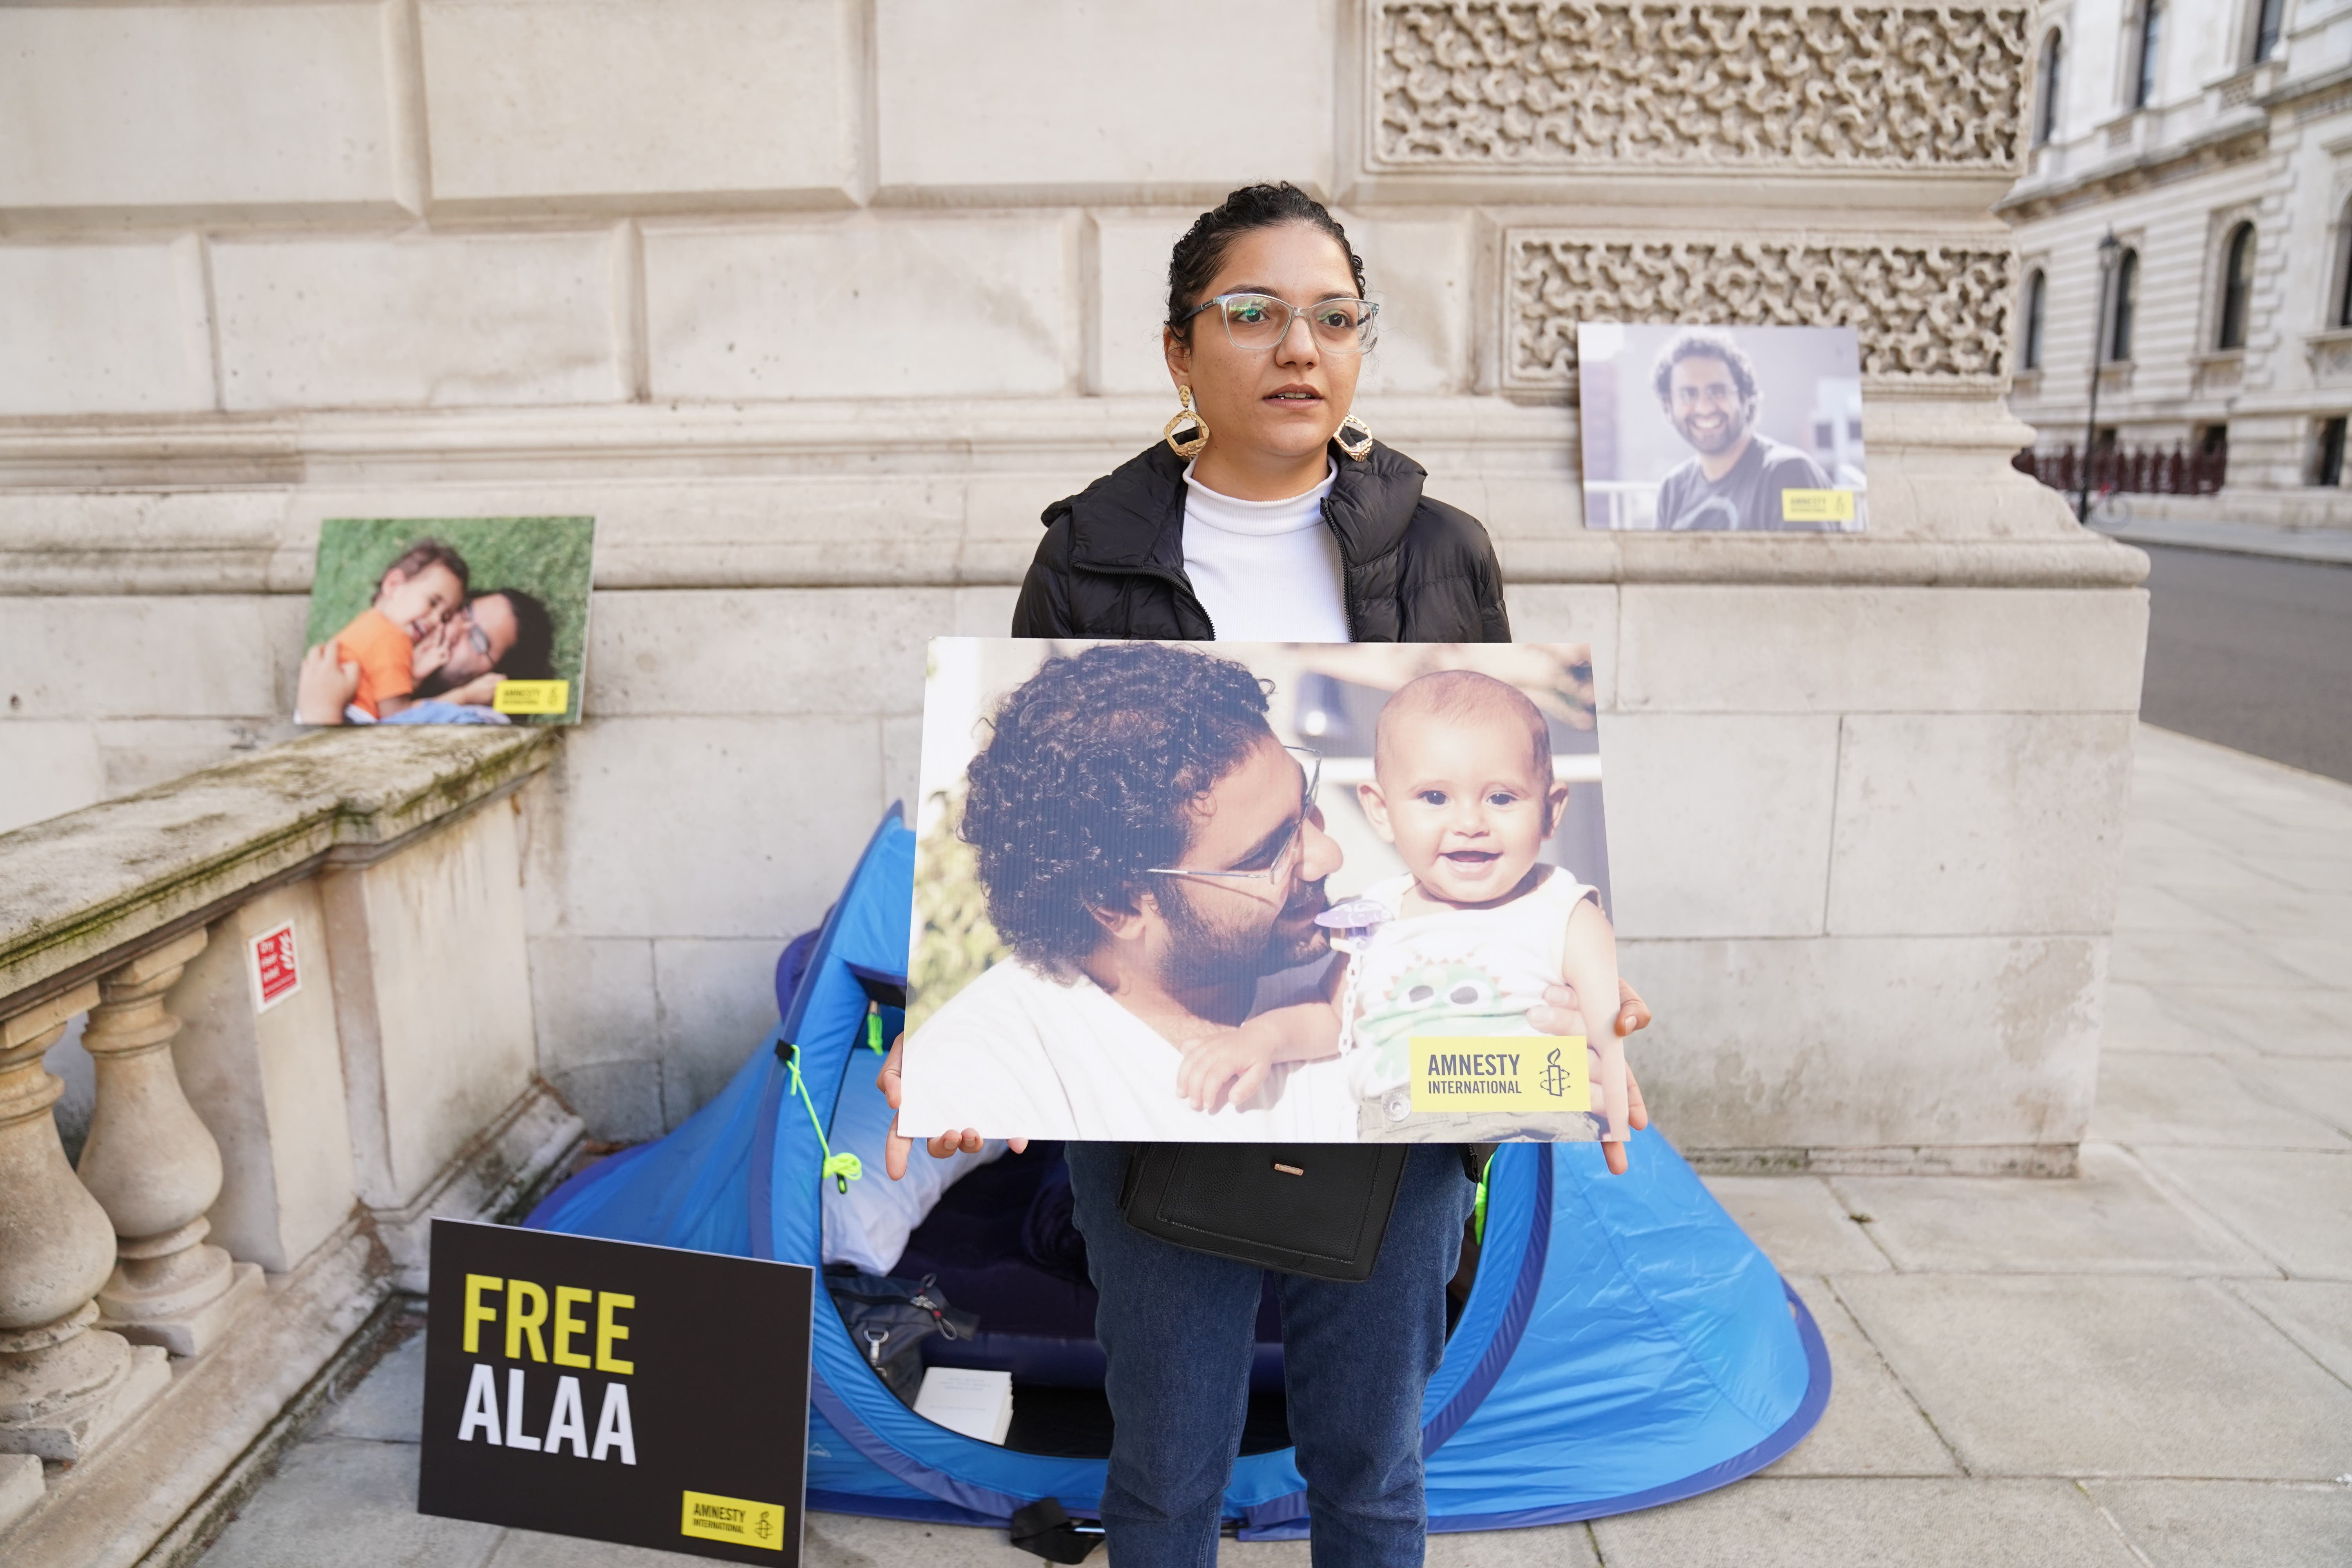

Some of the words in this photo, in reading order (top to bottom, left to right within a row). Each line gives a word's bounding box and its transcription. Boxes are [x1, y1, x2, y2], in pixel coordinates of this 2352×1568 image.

[1428, 1054, 1520, 1076] AMNESTY
[1428, 1081, 1522, 1094] INTERNATIONAL
[463, 1273, 635, 1375] FREE
[457, 1364, 636, 1465] ALAA
[693, 1503, 746, 1523] AMNESTY
[693, 1518, 744, 1534] INTERNATIONAL
